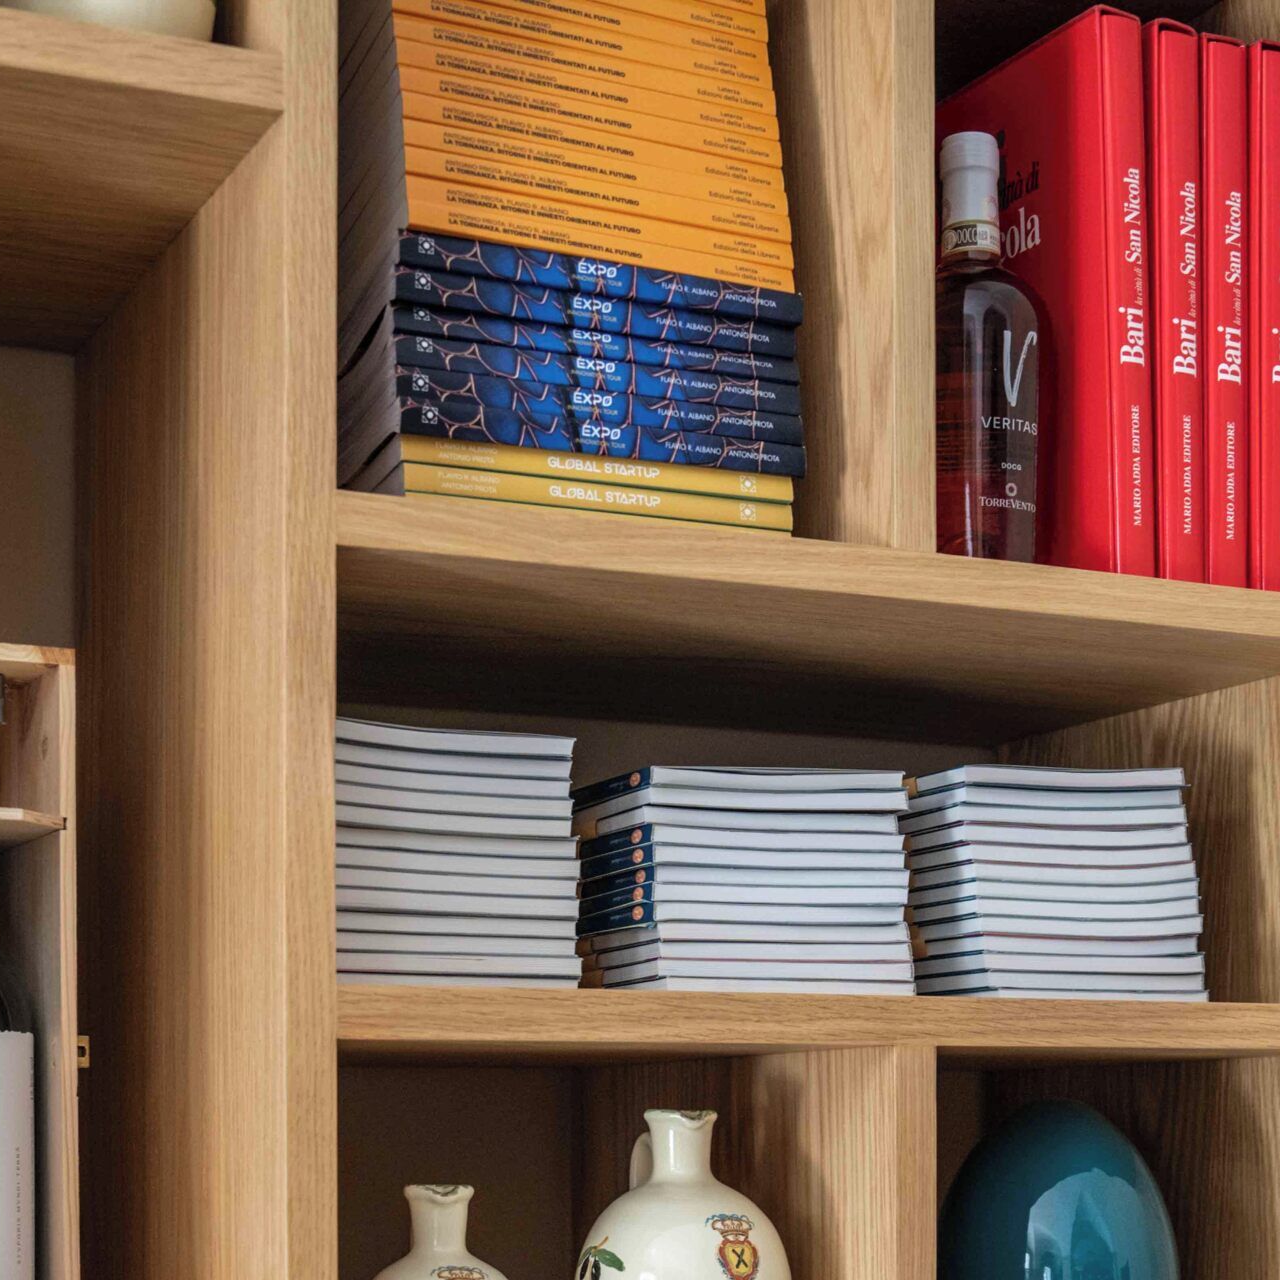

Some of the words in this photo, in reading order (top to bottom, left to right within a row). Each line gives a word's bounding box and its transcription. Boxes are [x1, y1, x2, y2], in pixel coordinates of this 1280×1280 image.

[1123, 167, 1141, 226] Nicola
[1180, 181, 1196, 238] Nicola
[1225, 191, 1241, 248] Nicola
[1125, 229, 1142, 265] San
[1180, 242, 1196, 278] San
[1225, 250, 1241, 286] San
[1118, 306, 1145, 367] Bari
[1172, 317, 1197, 378] Bari
[1217, 325, 1241, 385] Bari
[981, 416, 1038, 435] VERITAS
[1131, 405, 1140, 454] EDITORE
[1183, 415, 1192, 463] EDITORE
[695, 445, 722, 456] ALBANO
[728, 449, 760, 460] ANTONIO
[1226, 421, 1235, 469] EDITORE
[547, 456, 601, 473] GLOBAL
[604, 463, 660, 478] STARTUP
[1001, 463, 1022, 471] DOCG
[1132, 456, 1141, 487] ADDA
[1184, 466, 1192, 495] ADDA
[549, 485, 602, 502] GLOBAL
[605, 492, 661, 507] STARTUP
[1226, 472, 1235, 501] ADDA
[1133, 488, 1142, 526] MARIO
[1184, 497, 1192, 535] MARIO
[1226, 502, 1235, 540] MARIO
